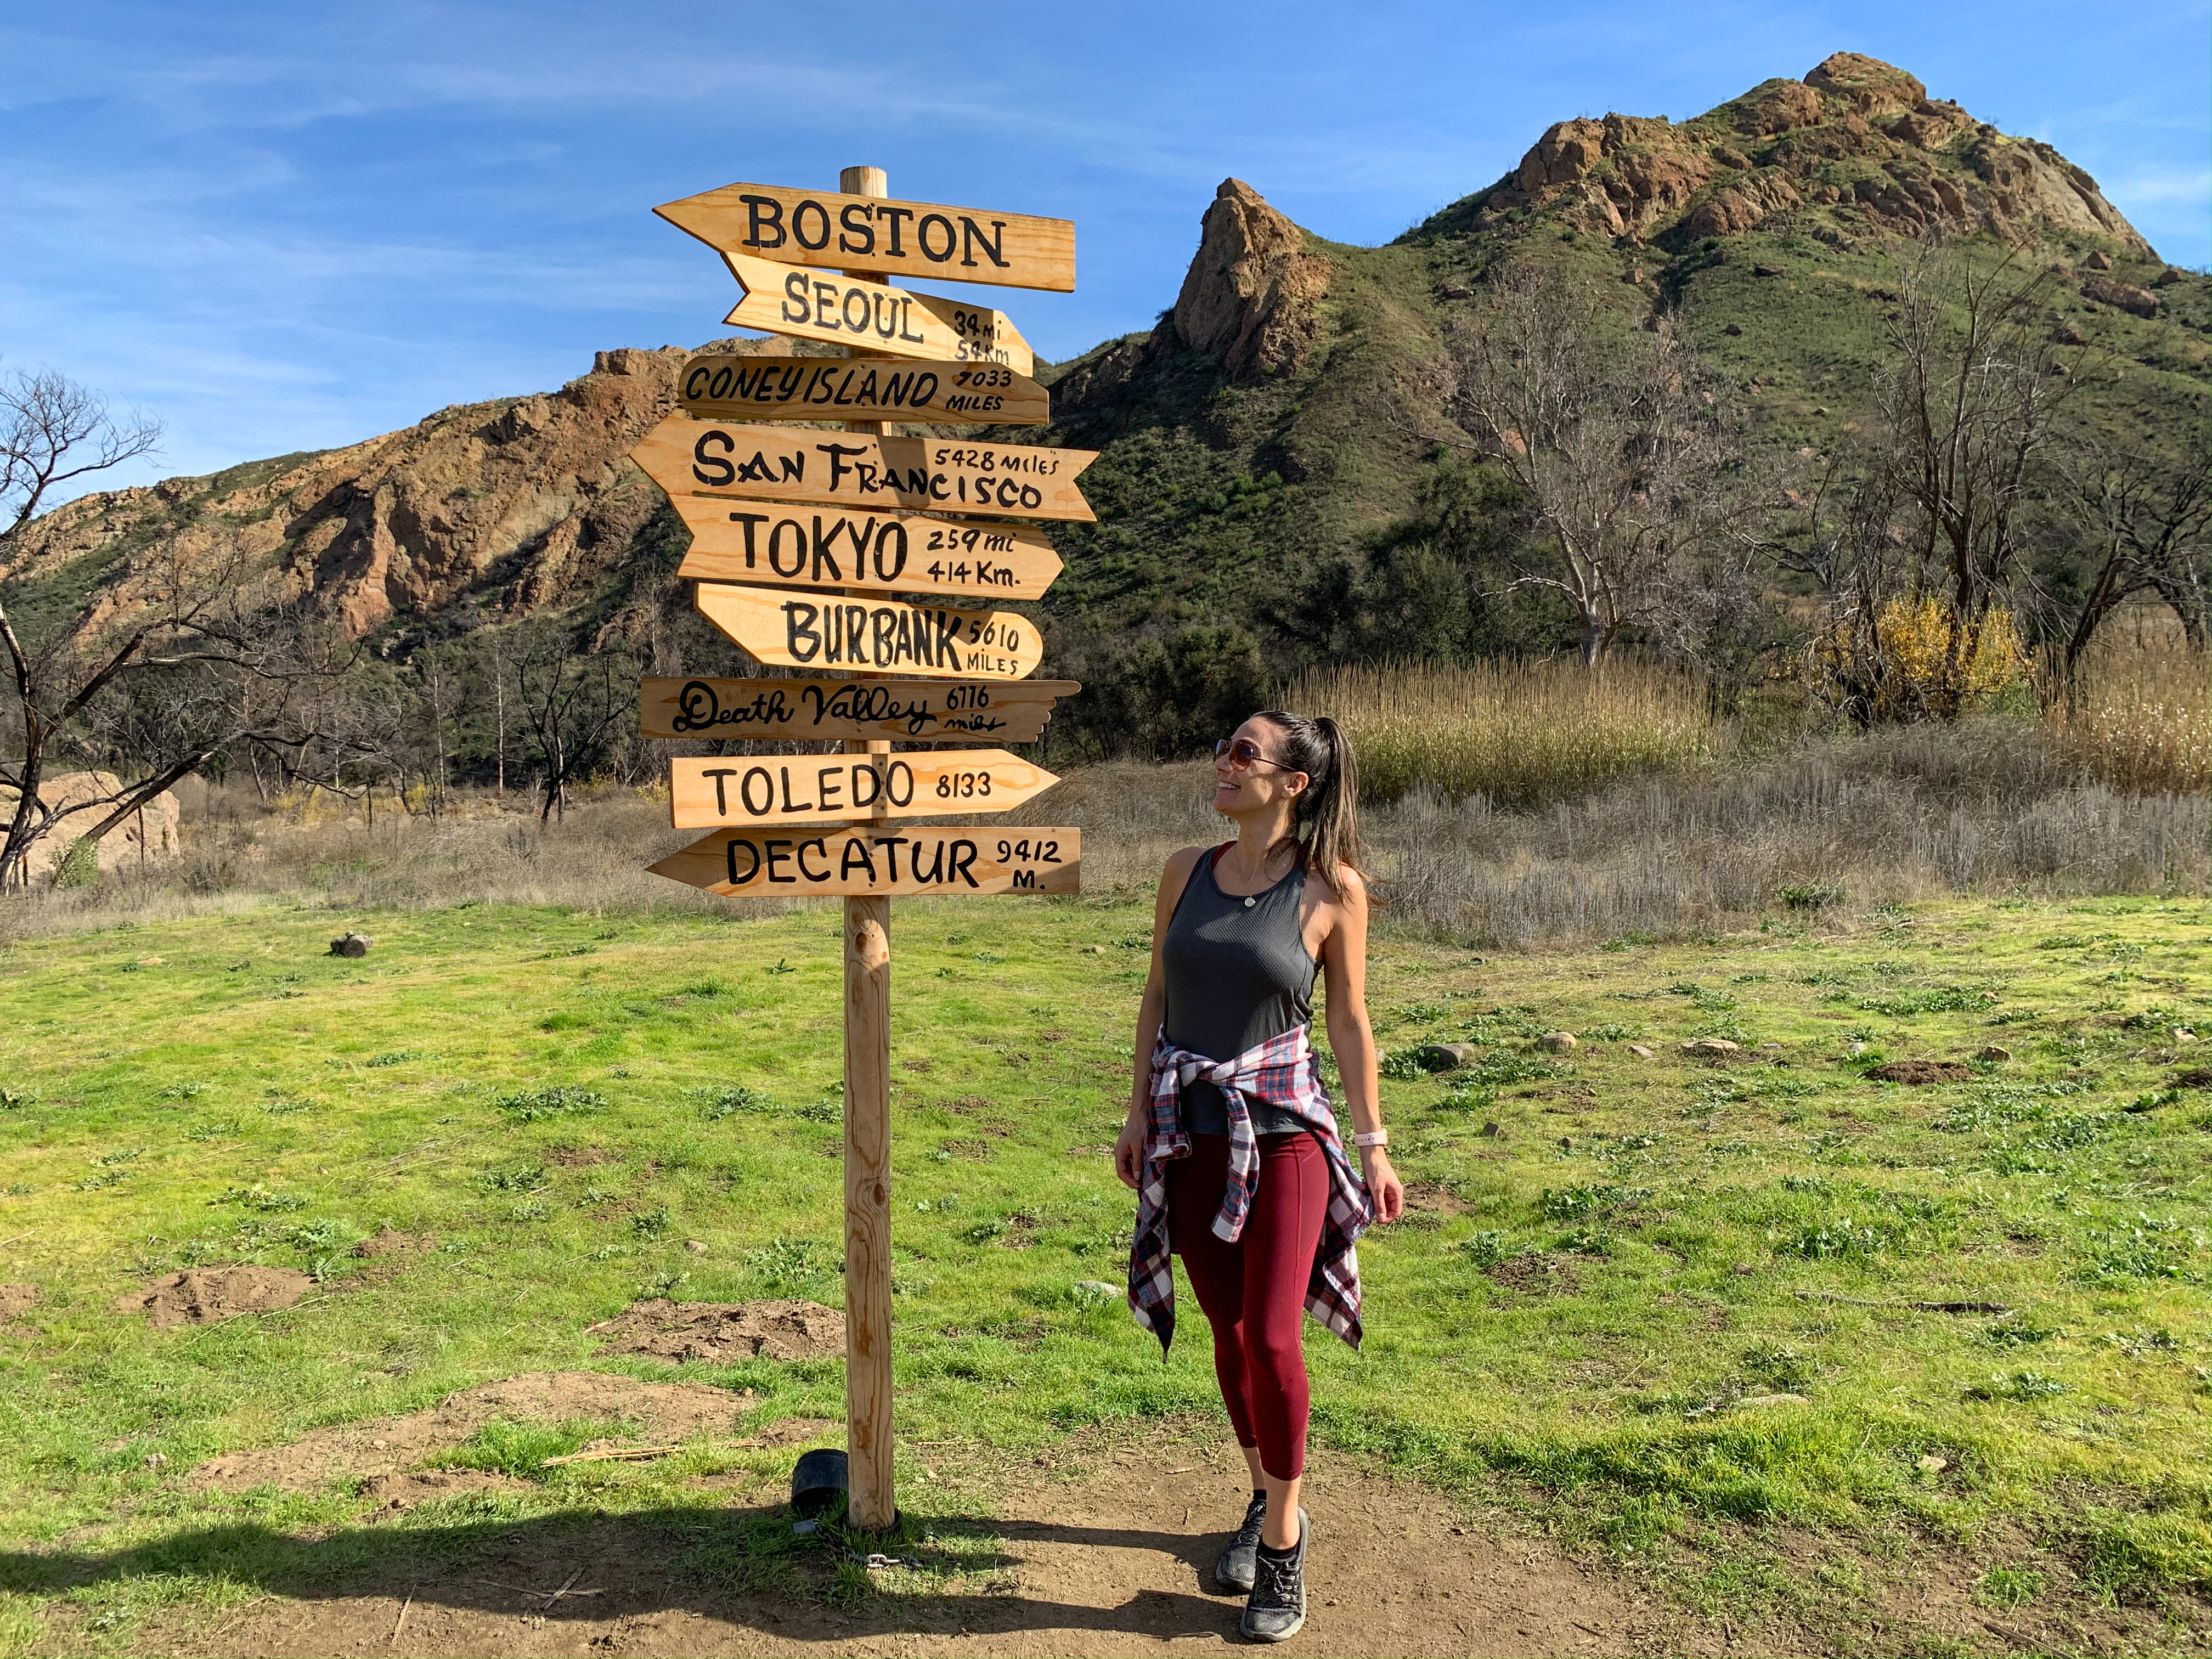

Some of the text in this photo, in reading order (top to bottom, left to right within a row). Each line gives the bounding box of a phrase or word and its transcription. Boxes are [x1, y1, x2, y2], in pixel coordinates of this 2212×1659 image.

[739, 194, 1011, 267] BOSTON
[782, 272, 924, 343] SEOUL
[686, 366, 938, 407] CONEY ISLAND
[956, 370, 1012, 387] 7033
[945, 394, 1005, 411] MILES
[693, 430, 1042, 509] SAN FRANCISCO
[935, 448, 994, 472] 5428
[729, 512, 908, 582] TOKYO
[927, 529, 1017, 553] 259 mi
[927, 561, 972, 584] 414
[781, 601, 963, 672] BURBANK
[969, 620, 1019, 652] 5610
[672, 681, 936, 735] Death Valley
[944, 715, 1007, 732] miles
[702, 761, 914, 816] TOLEDO
[936, 772, 991, 798] 8133
[727, 838, 979, 889] DECATUR
[996, 840, 1062, 864] 9412
[1012, 870, 1046, 890] M.
